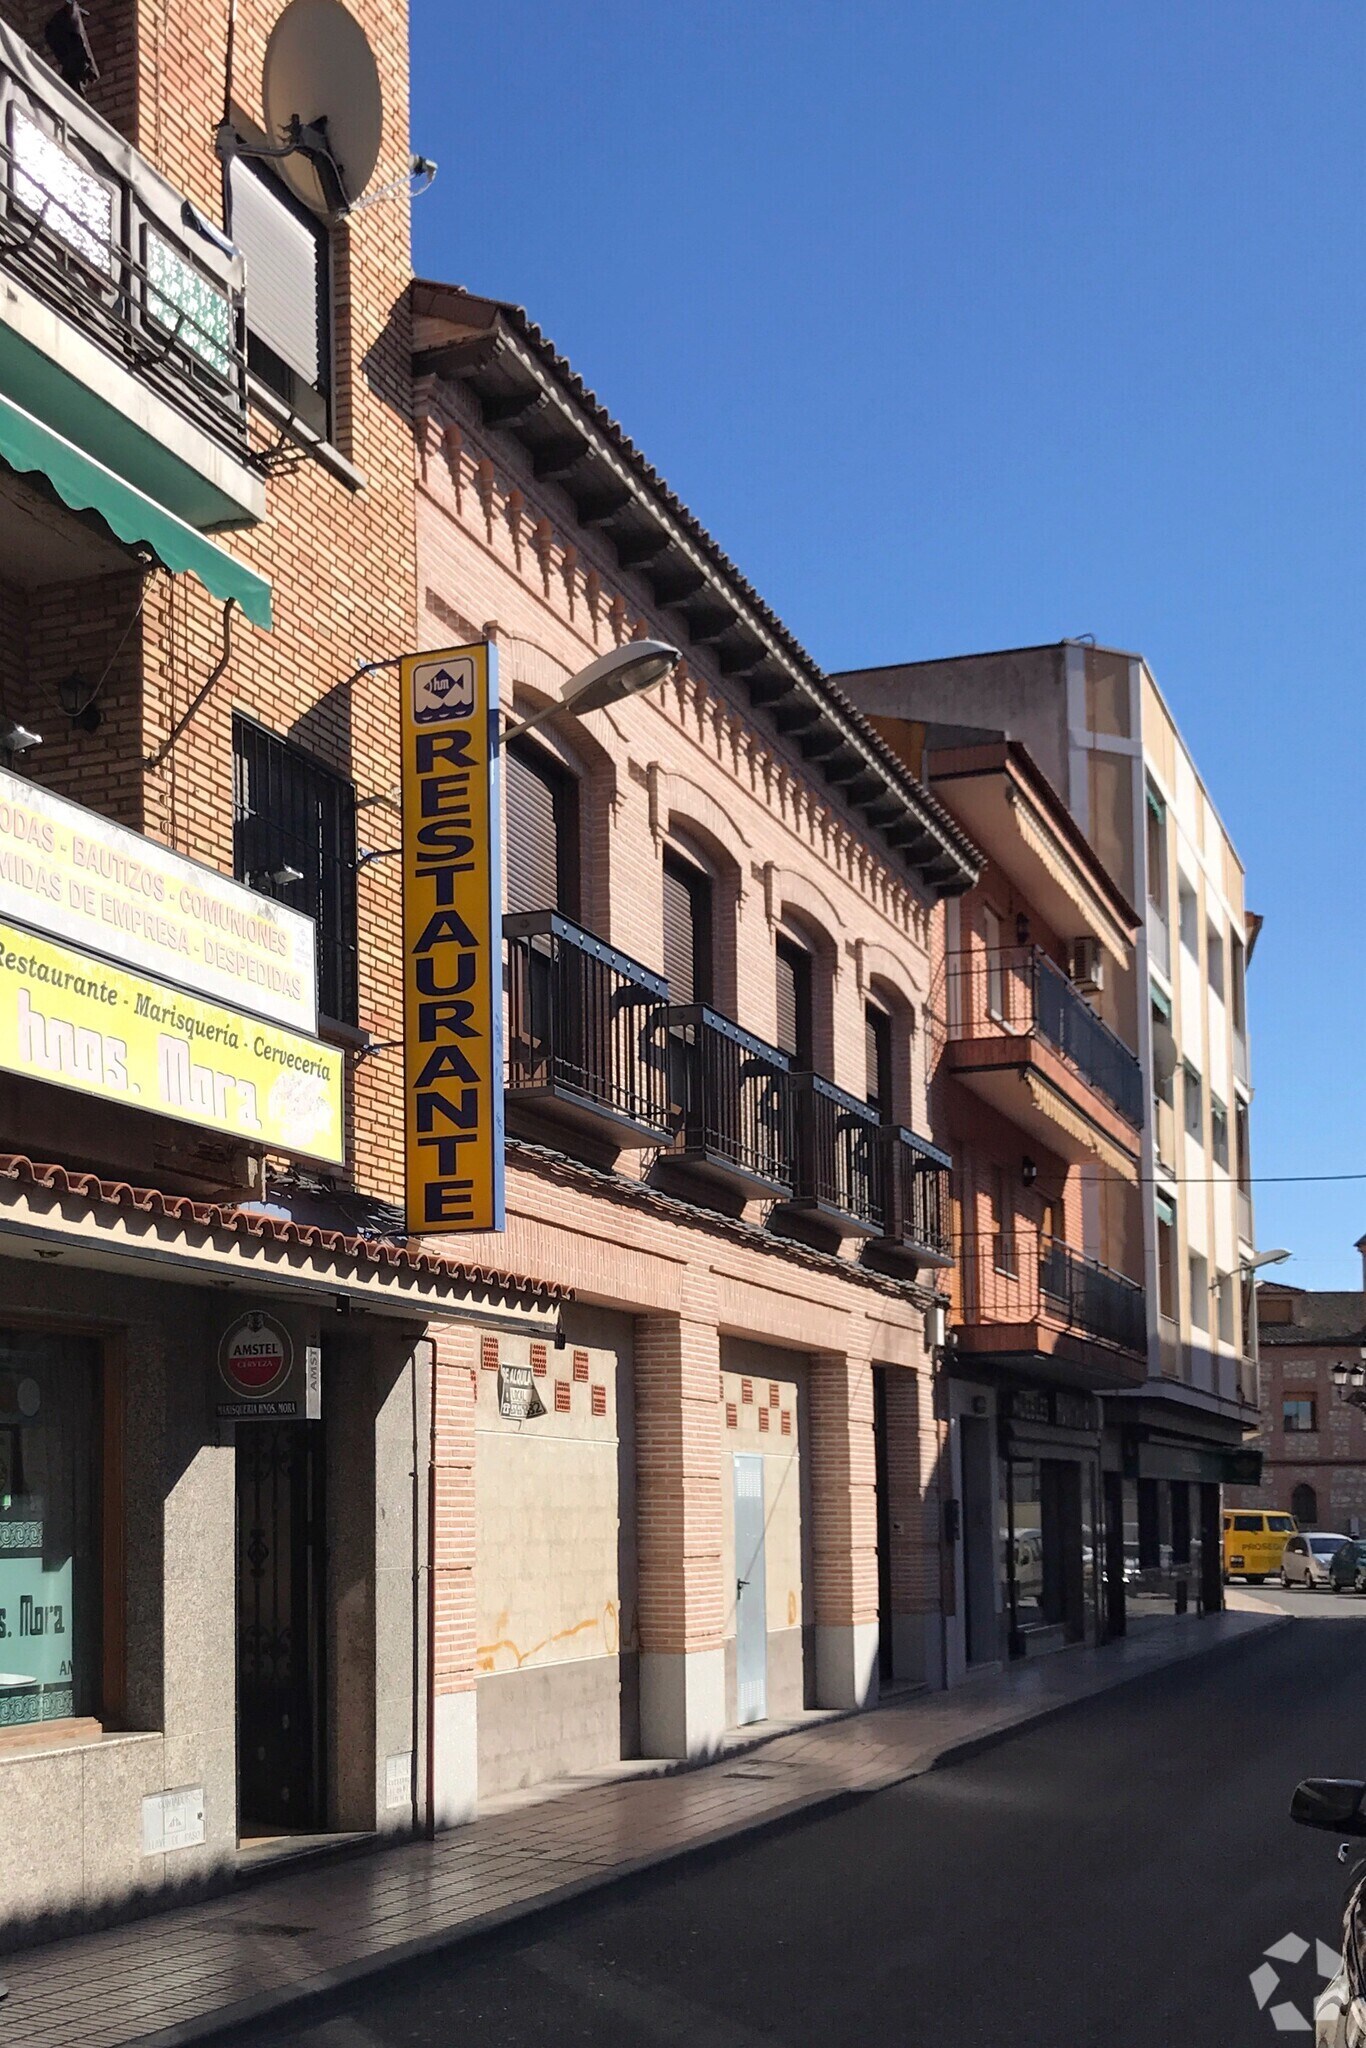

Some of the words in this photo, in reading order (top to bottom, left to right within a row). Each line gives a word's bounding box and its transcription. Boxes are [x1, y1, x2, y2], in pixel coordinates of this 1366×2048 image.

[433, 677, 449, 691] hm
[73, 836, 165, 902] BAUTIZOS
[179, 886, 287, 957] COMUNIONES
[69, 879, 96, 917] DE
[101, 893, 190, 955] EMPRESA
[204, 937, 301, 1000] DESPEDIDAS
[411, 730, 483, 1224] RESTAURANTE
[133, 992, 239, 1050] Marisquería
[253, 1036, 331, 1081] Cervecería
[233, 1344, 278, 1356] AMSTEL
[237, 1361, 273, 1369] CERVEZA
[20, 1594, 65, 1637] Mora
